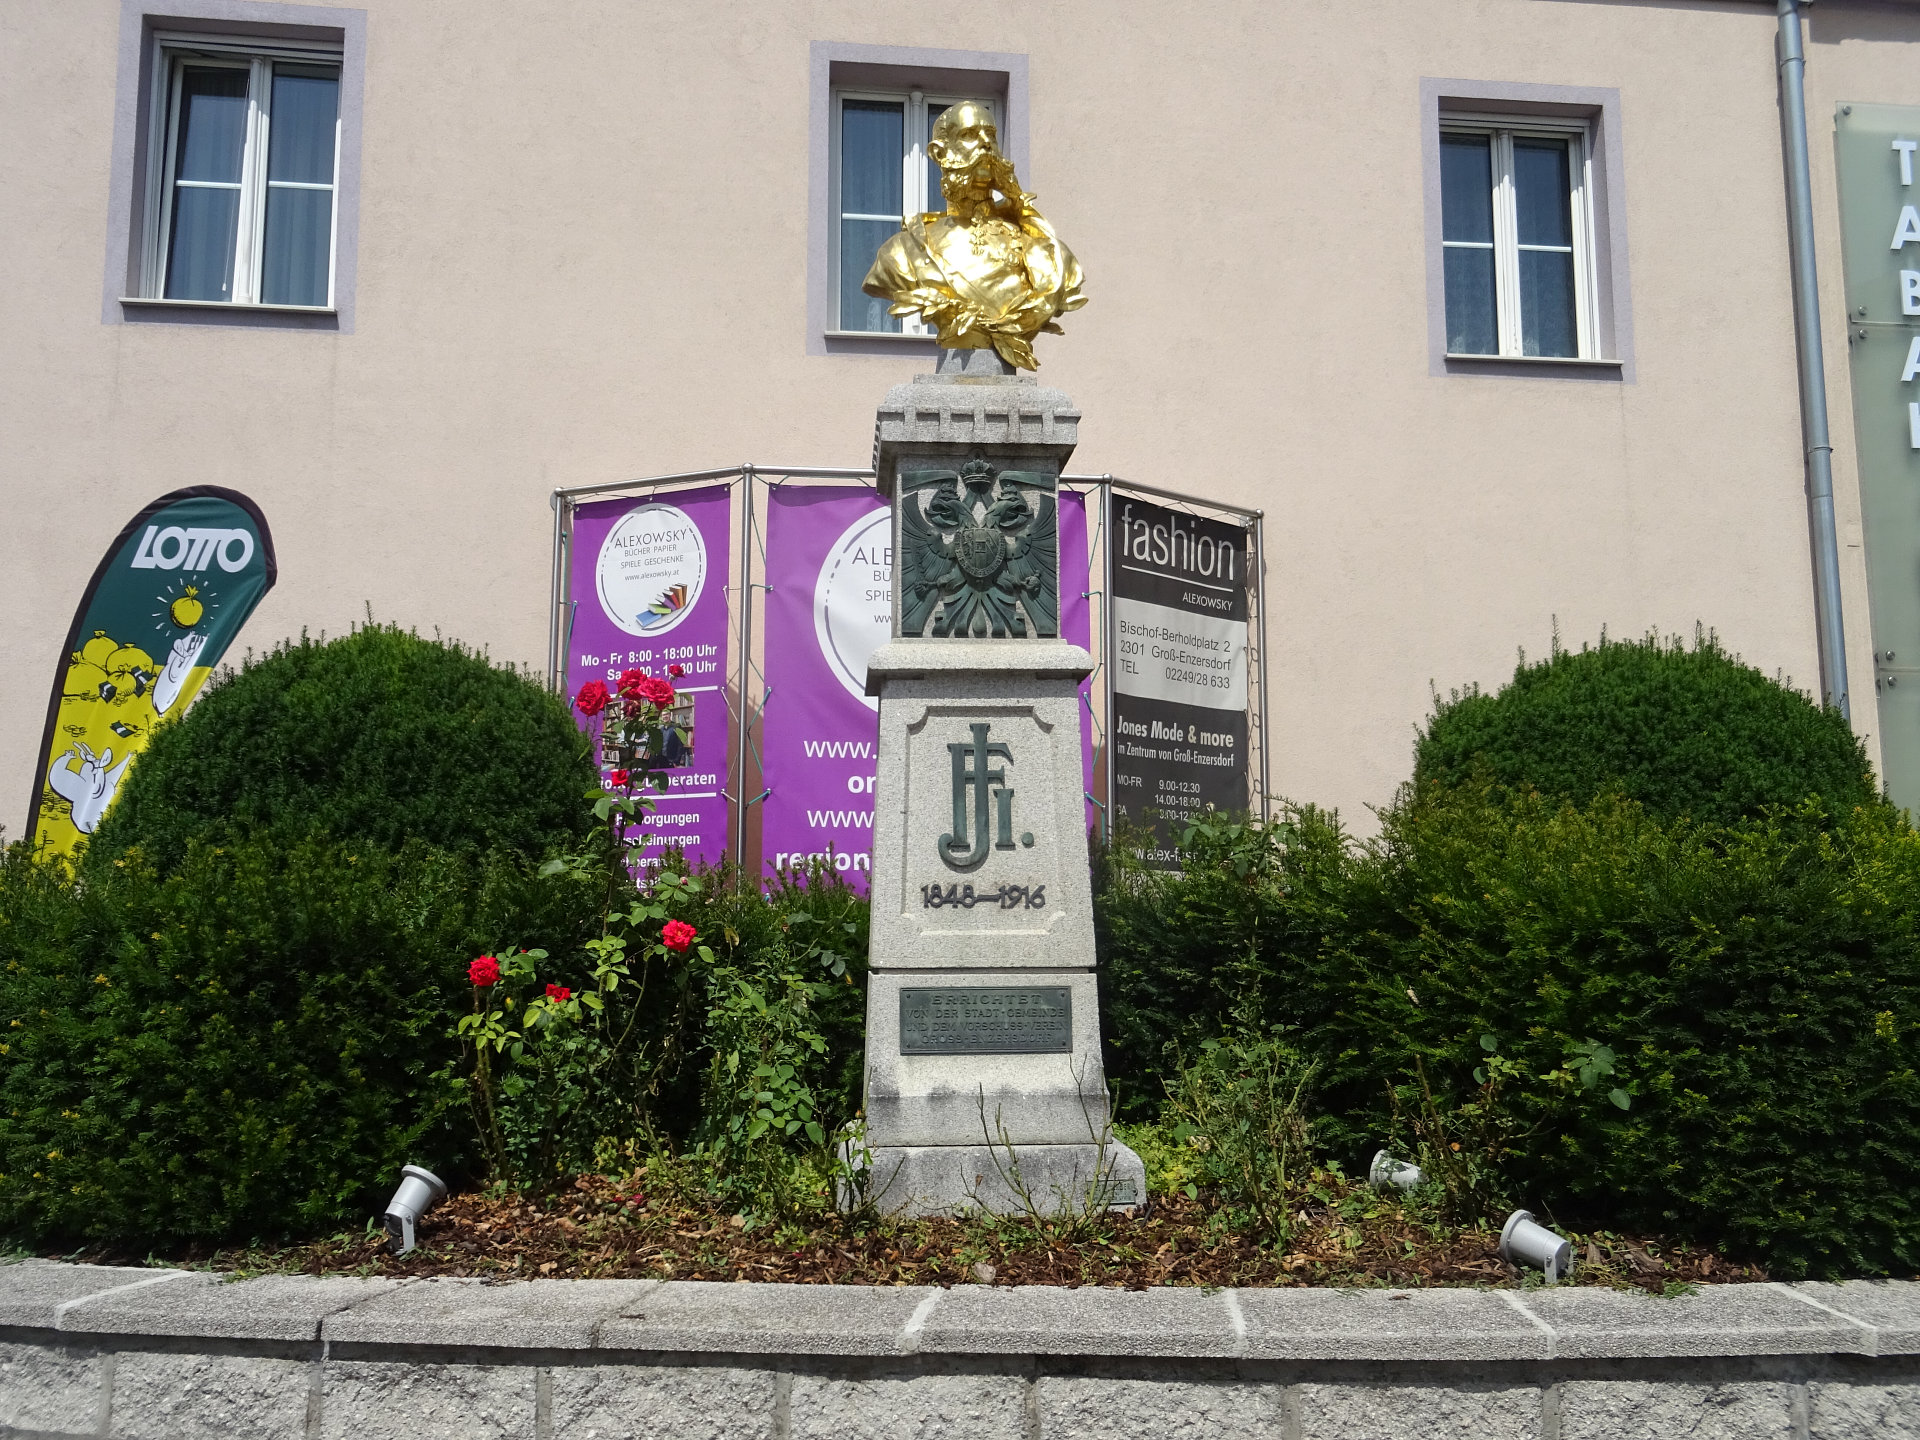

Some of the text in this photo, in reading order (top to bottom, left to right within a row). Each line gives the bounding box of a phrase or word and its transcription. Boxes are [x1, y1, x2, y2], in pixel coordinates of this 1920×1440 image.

[614, 528, 688, 549] ALEXOWSKY
[1121, 504, 1234, 581] fashion
[130, 525, 254, 573] LOTTO
[624, 544, 677, 557] BÜCHER PAPIER
[621, 555, 684, 569] SPIELE GESCHENKE
[625, 569, 679, 582] www.alexowsky.at
[1182, 592, 1233, 611] ALEXOWSKY
[581, 655, 600, 667] Mo
[610, 653, 623, 665] Fr
[628, 650, 652, 663] 8:00
[663, 646, 693, 660] 18:00
[696, 644, 717, 657] Uhr
[1120, 640, 1232, 671] 2301 Groß-Enzersdorf
[1223, 640, 1231, 653] 2
[696, 660, 717, 673] Uhr
[1120, 659, 1230, 689] TEL 02249/28 633
[1117, 715, 1234, 748] Jones Mode & more
[803, 740, 878, 760] www.
[1117, 741, 1234, 767] im Zentrum von Groß-Enzersdorf
[1117, 774, 1200, 794] MO-FR 9.00-12.30
[1154, 794, 1201, 808] 14.00-18.00
[931, 994, 1043, 1006] ERRICHTET
[906, 1009, 929, 1019] VON
[935, 1009, 959, 1019] DER
[905, 1022, 929, 1032] UND
[932, 1022, 957, 1032] DEM
